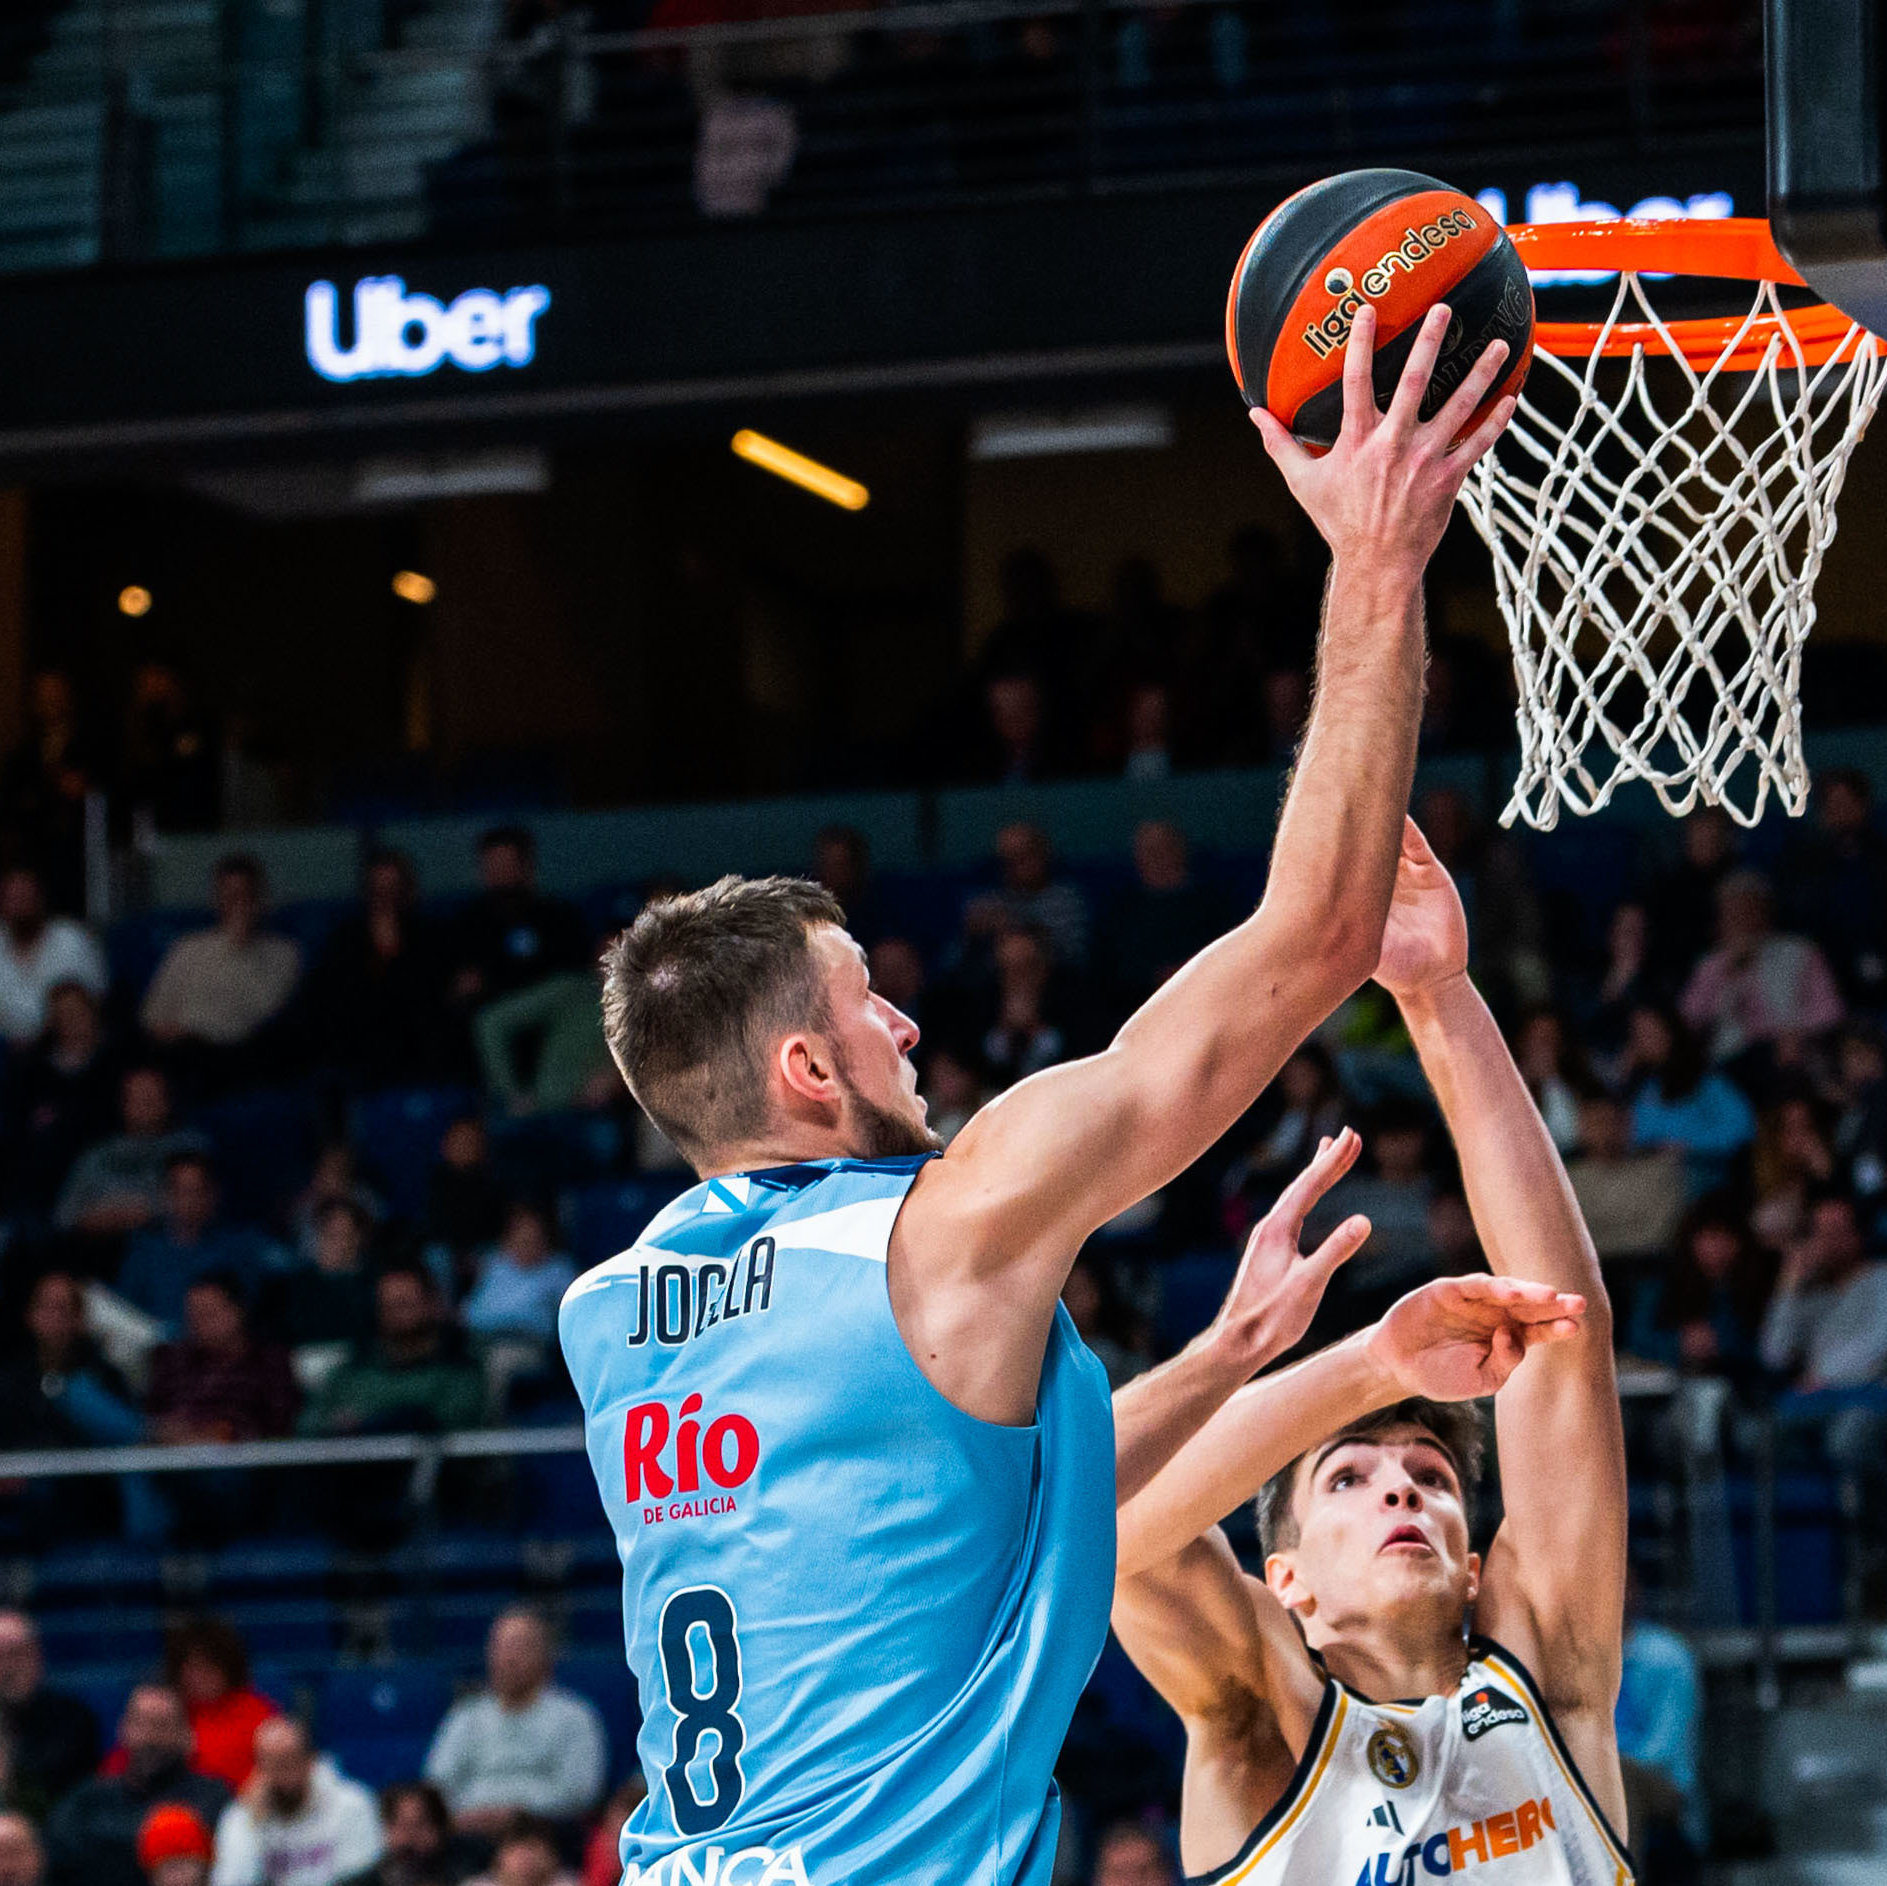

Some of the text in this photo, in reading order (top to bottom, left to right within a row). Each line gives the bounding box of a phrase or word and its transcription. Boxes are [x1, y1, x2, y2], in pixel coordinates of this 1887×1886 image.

[303, 274, 552, 383] Uber
[1302, 209, 1477, 360] liga endesa
[623, 1391, 760, 1505] Río
[643, 1495, 737, 1525] DE GALICIA
[659, 1583, 747, 1838] 8
